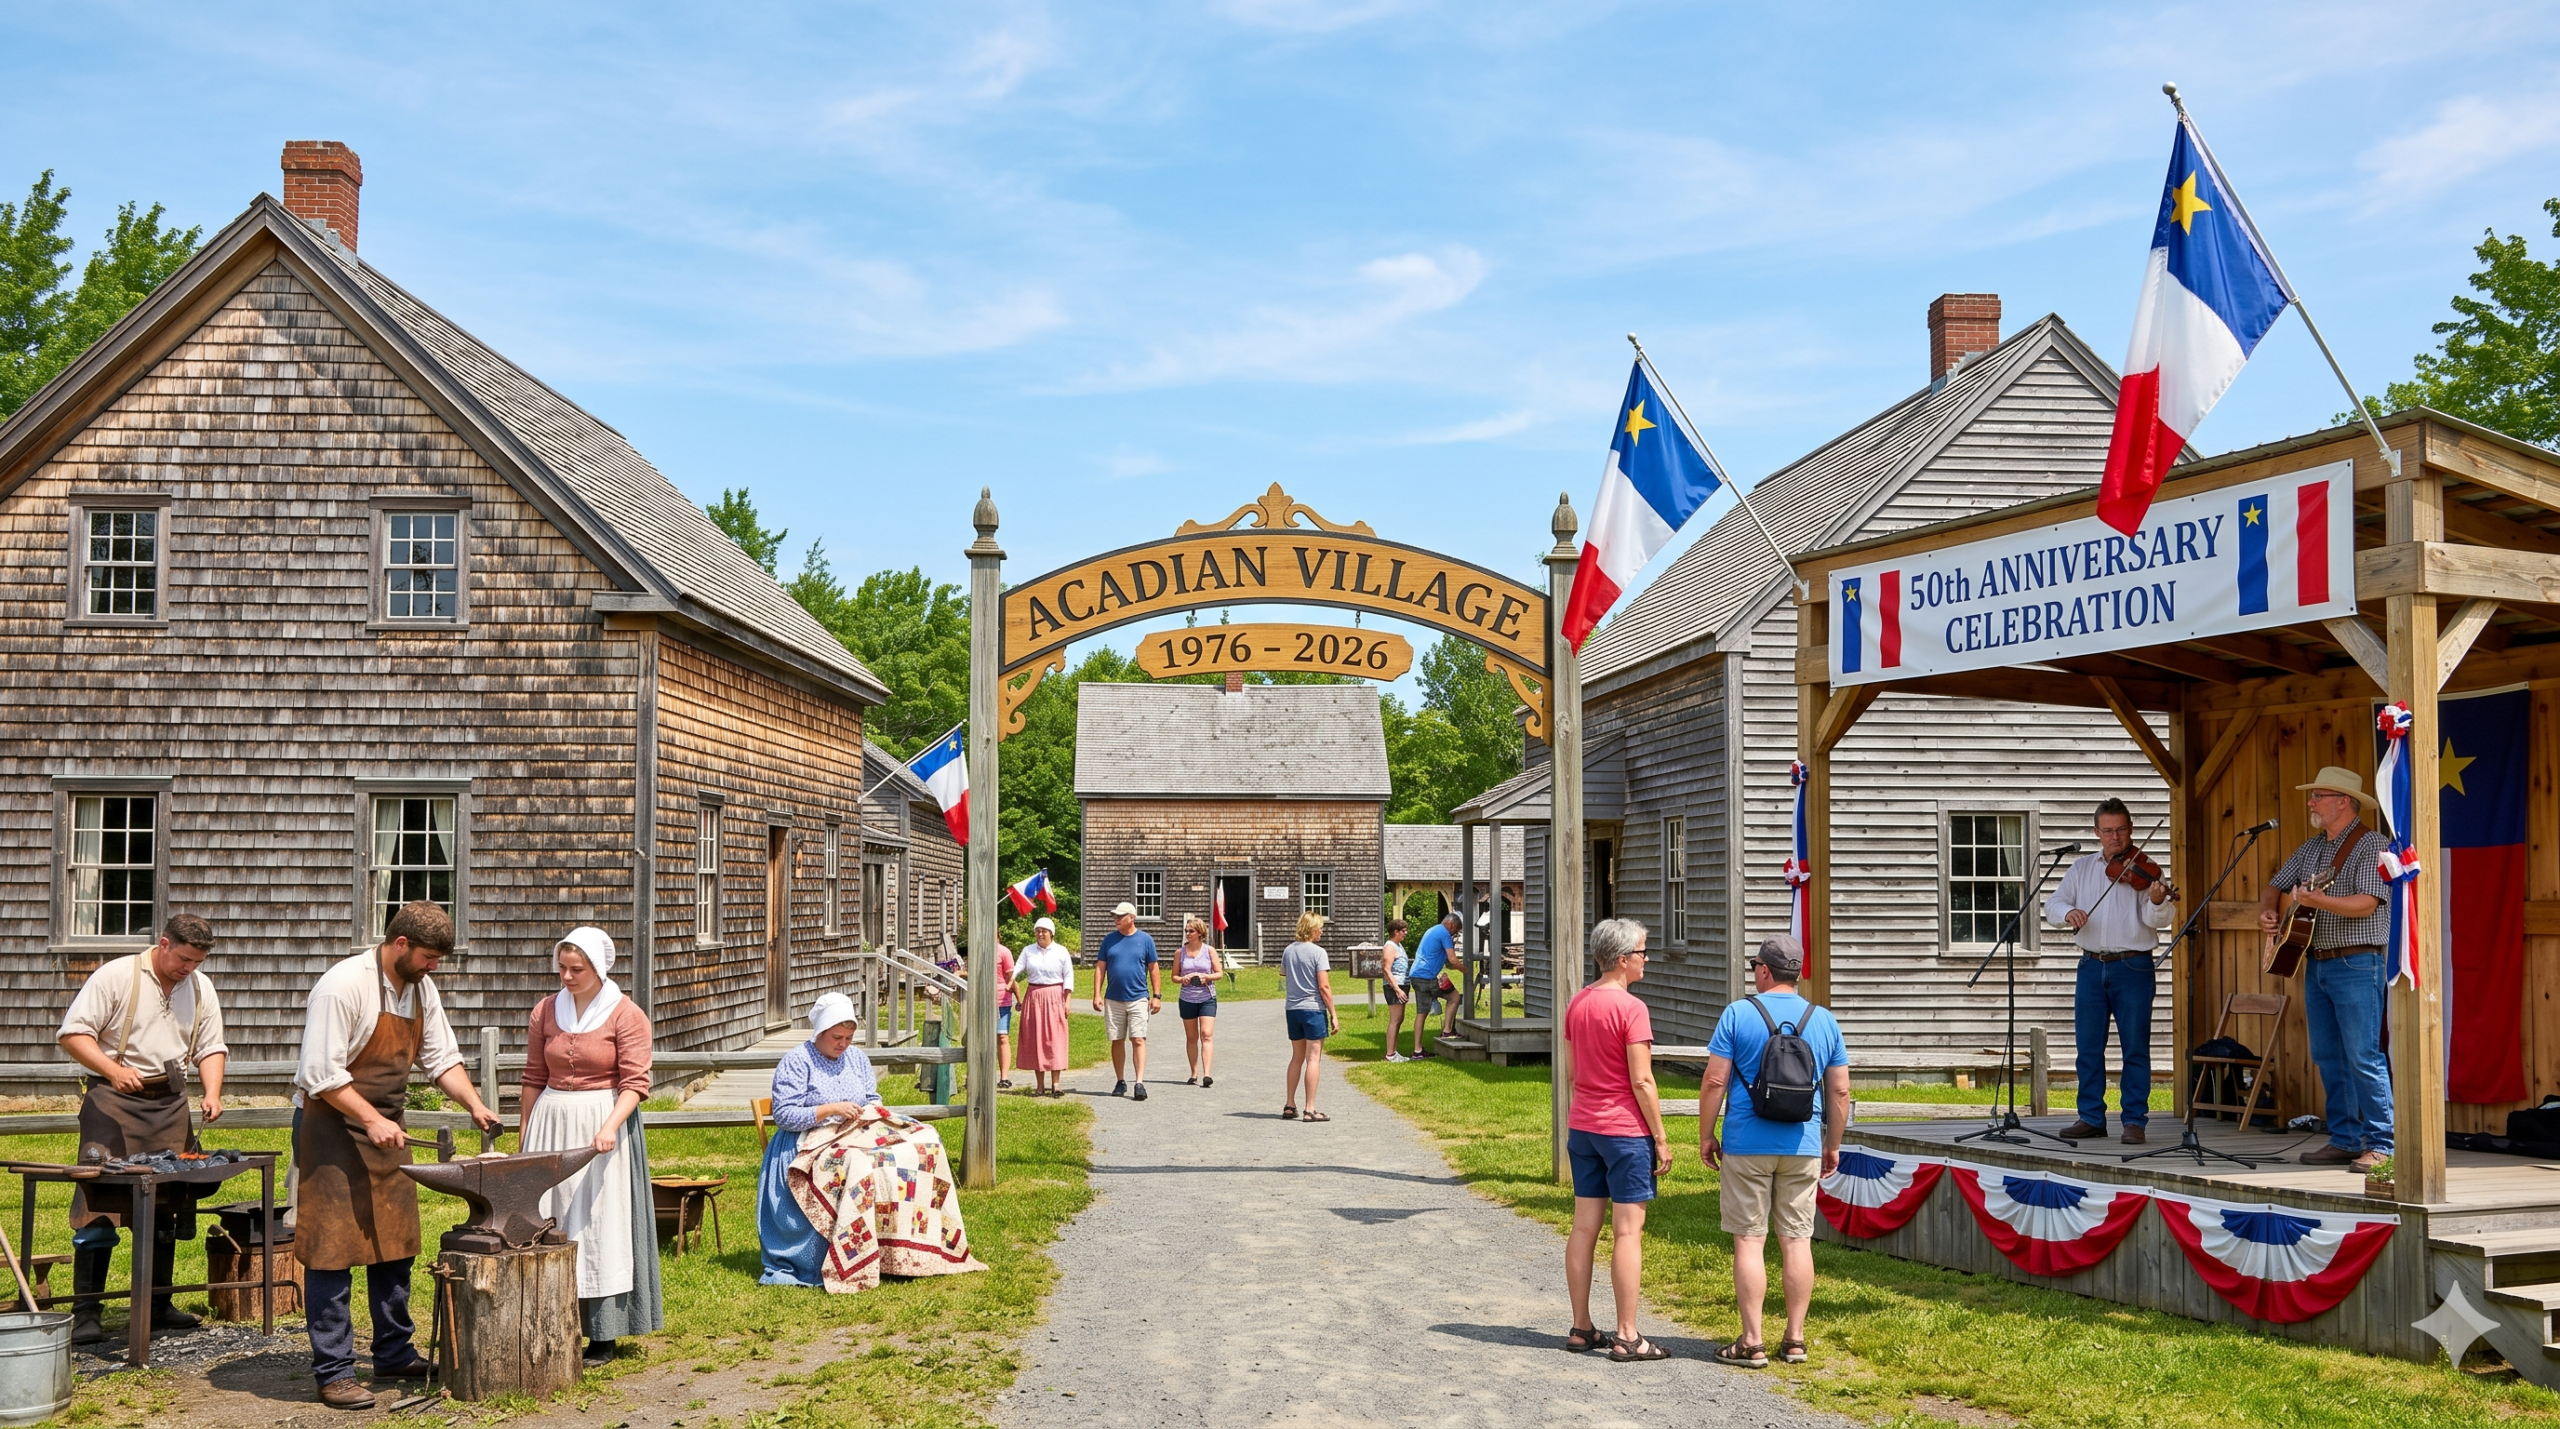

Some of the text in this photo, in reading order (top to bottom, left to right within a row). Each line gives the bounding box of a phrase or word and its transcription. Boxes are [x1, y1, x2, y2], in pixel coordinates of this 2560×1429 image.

[1028, 546, 1530, 642] ACADIAN VILLAGE
[1910, 513, 2225, 612] 50th ANNIVERSARY
[1158, 632, 1252, 670] 1976
[1293, 632, 1389, 670] 2026
[1945, 580, 2177, 654] CELEBRATION
